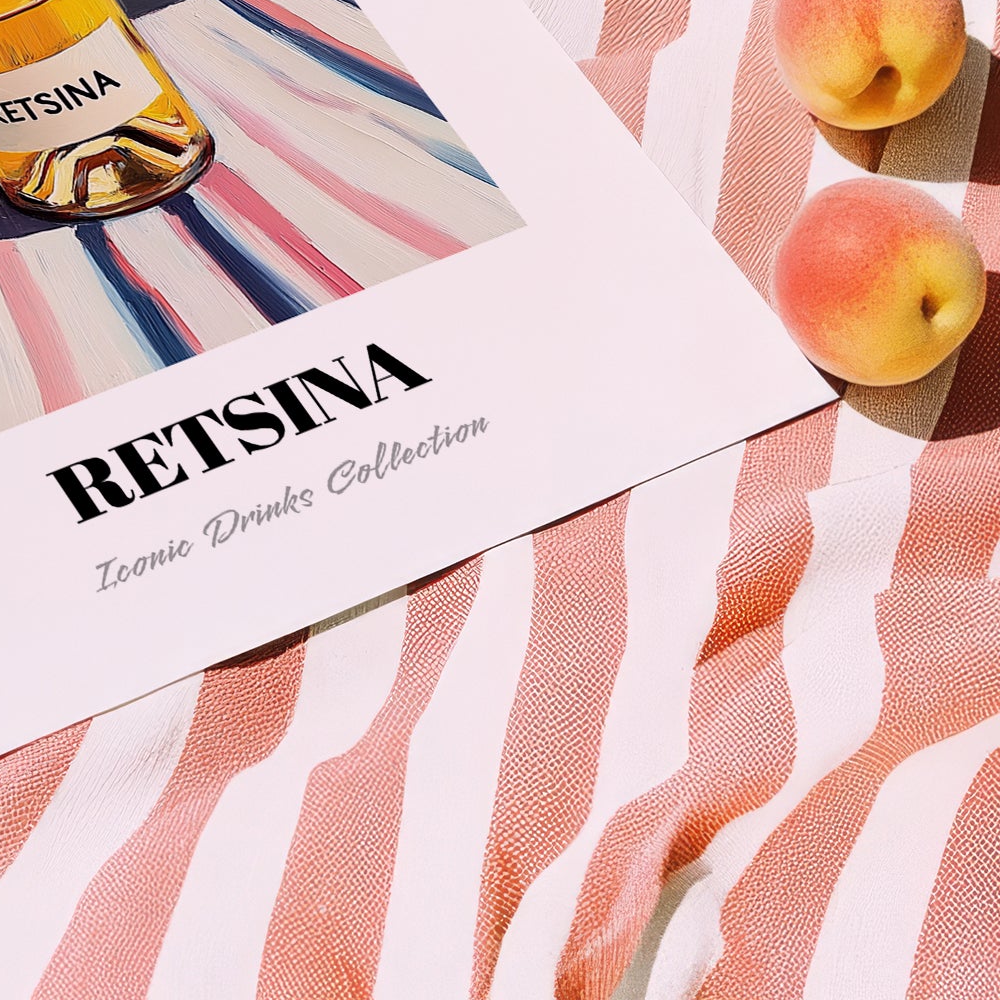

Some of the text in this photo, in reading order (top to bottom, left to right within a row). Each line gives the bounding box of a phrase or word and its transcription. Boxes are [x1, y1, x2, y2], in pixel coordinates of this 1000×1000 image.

[46, 343, 433, 524] RETSINA
[95, 416, 491, 593] Iconic Drinks Collection
